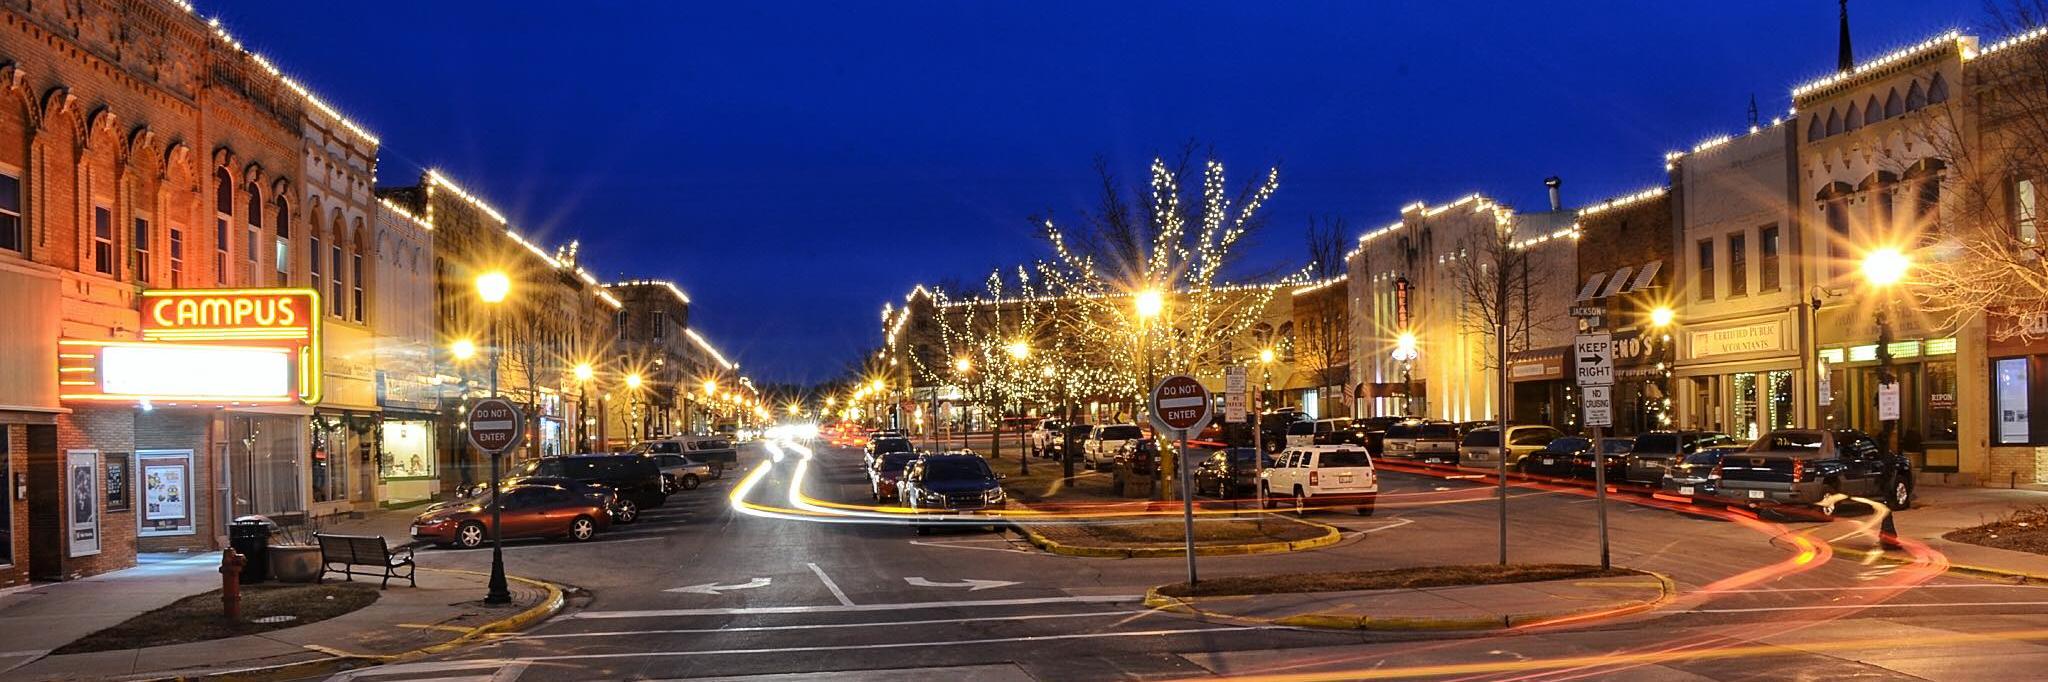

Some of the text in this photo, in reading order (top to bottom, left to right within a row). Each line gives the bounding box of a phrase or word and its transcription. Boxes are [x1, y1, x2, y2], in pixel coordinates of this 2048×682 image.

[153, 297, 295, 327] CAMPUS
[1572, 306, 1601, 316] JACKSON
[1713, 325, 1775, 341] CERTIFIED PUBLIC
[1578, 342, 1608, 353] KEEP
[1722, 340, 1769, 353] ACCOUNTANTS
[1579, 366, 1610, 377] RIGHT
[1163, 384, 1197, 396] DO NOT
[1592, 389, 1601, 398] NO
[1931, 393, 1953, 401] RIPON
[477, 409, 507, 418] DO NOT
[1168, 410, 1196, 420] ENTER
[480, 432, 506, 441] ENTER
